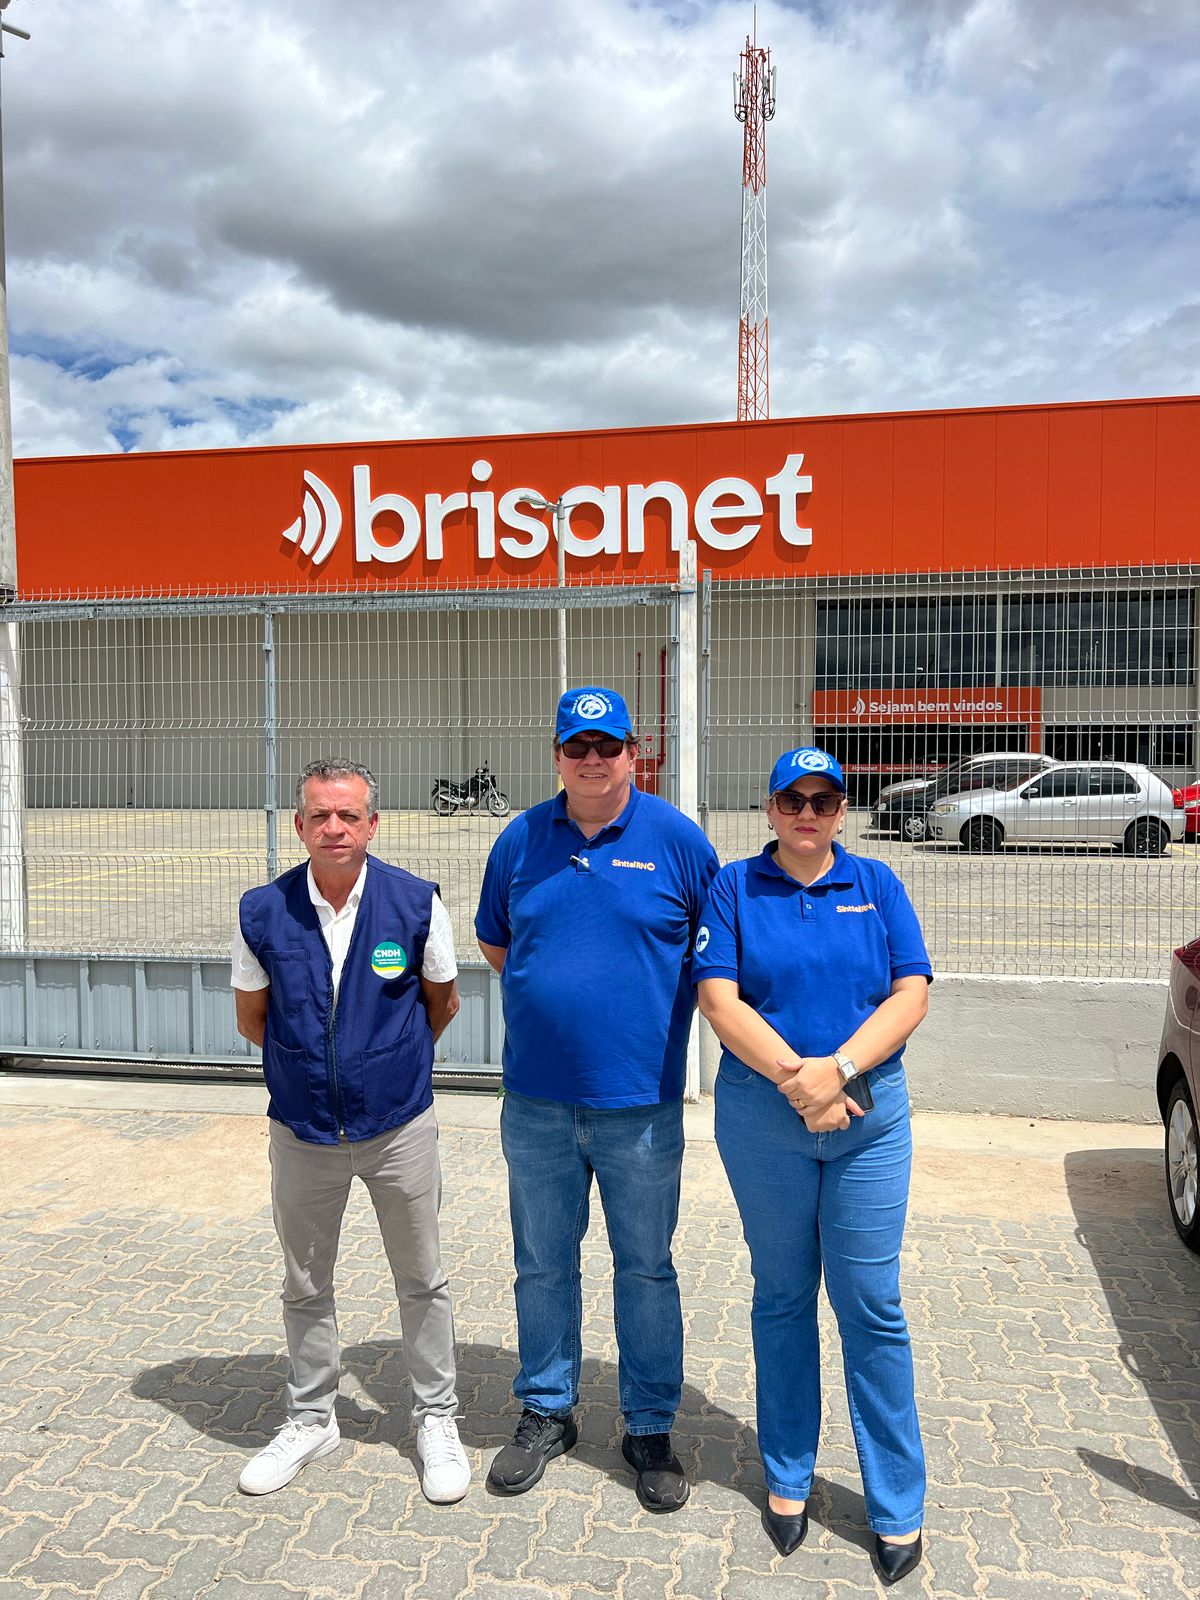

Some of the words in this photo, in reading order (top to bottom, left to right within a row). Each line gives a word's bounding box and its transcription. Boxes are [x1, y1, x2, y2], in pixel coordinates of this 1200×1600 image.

[353, 453, 813, 563] brisanet
[869, 700, 914, 714] Sejam
[917, 700, 950, 711] bem
[953, 699, 1003, 711] vindos
[374, 949, 401, 957] CNDH
